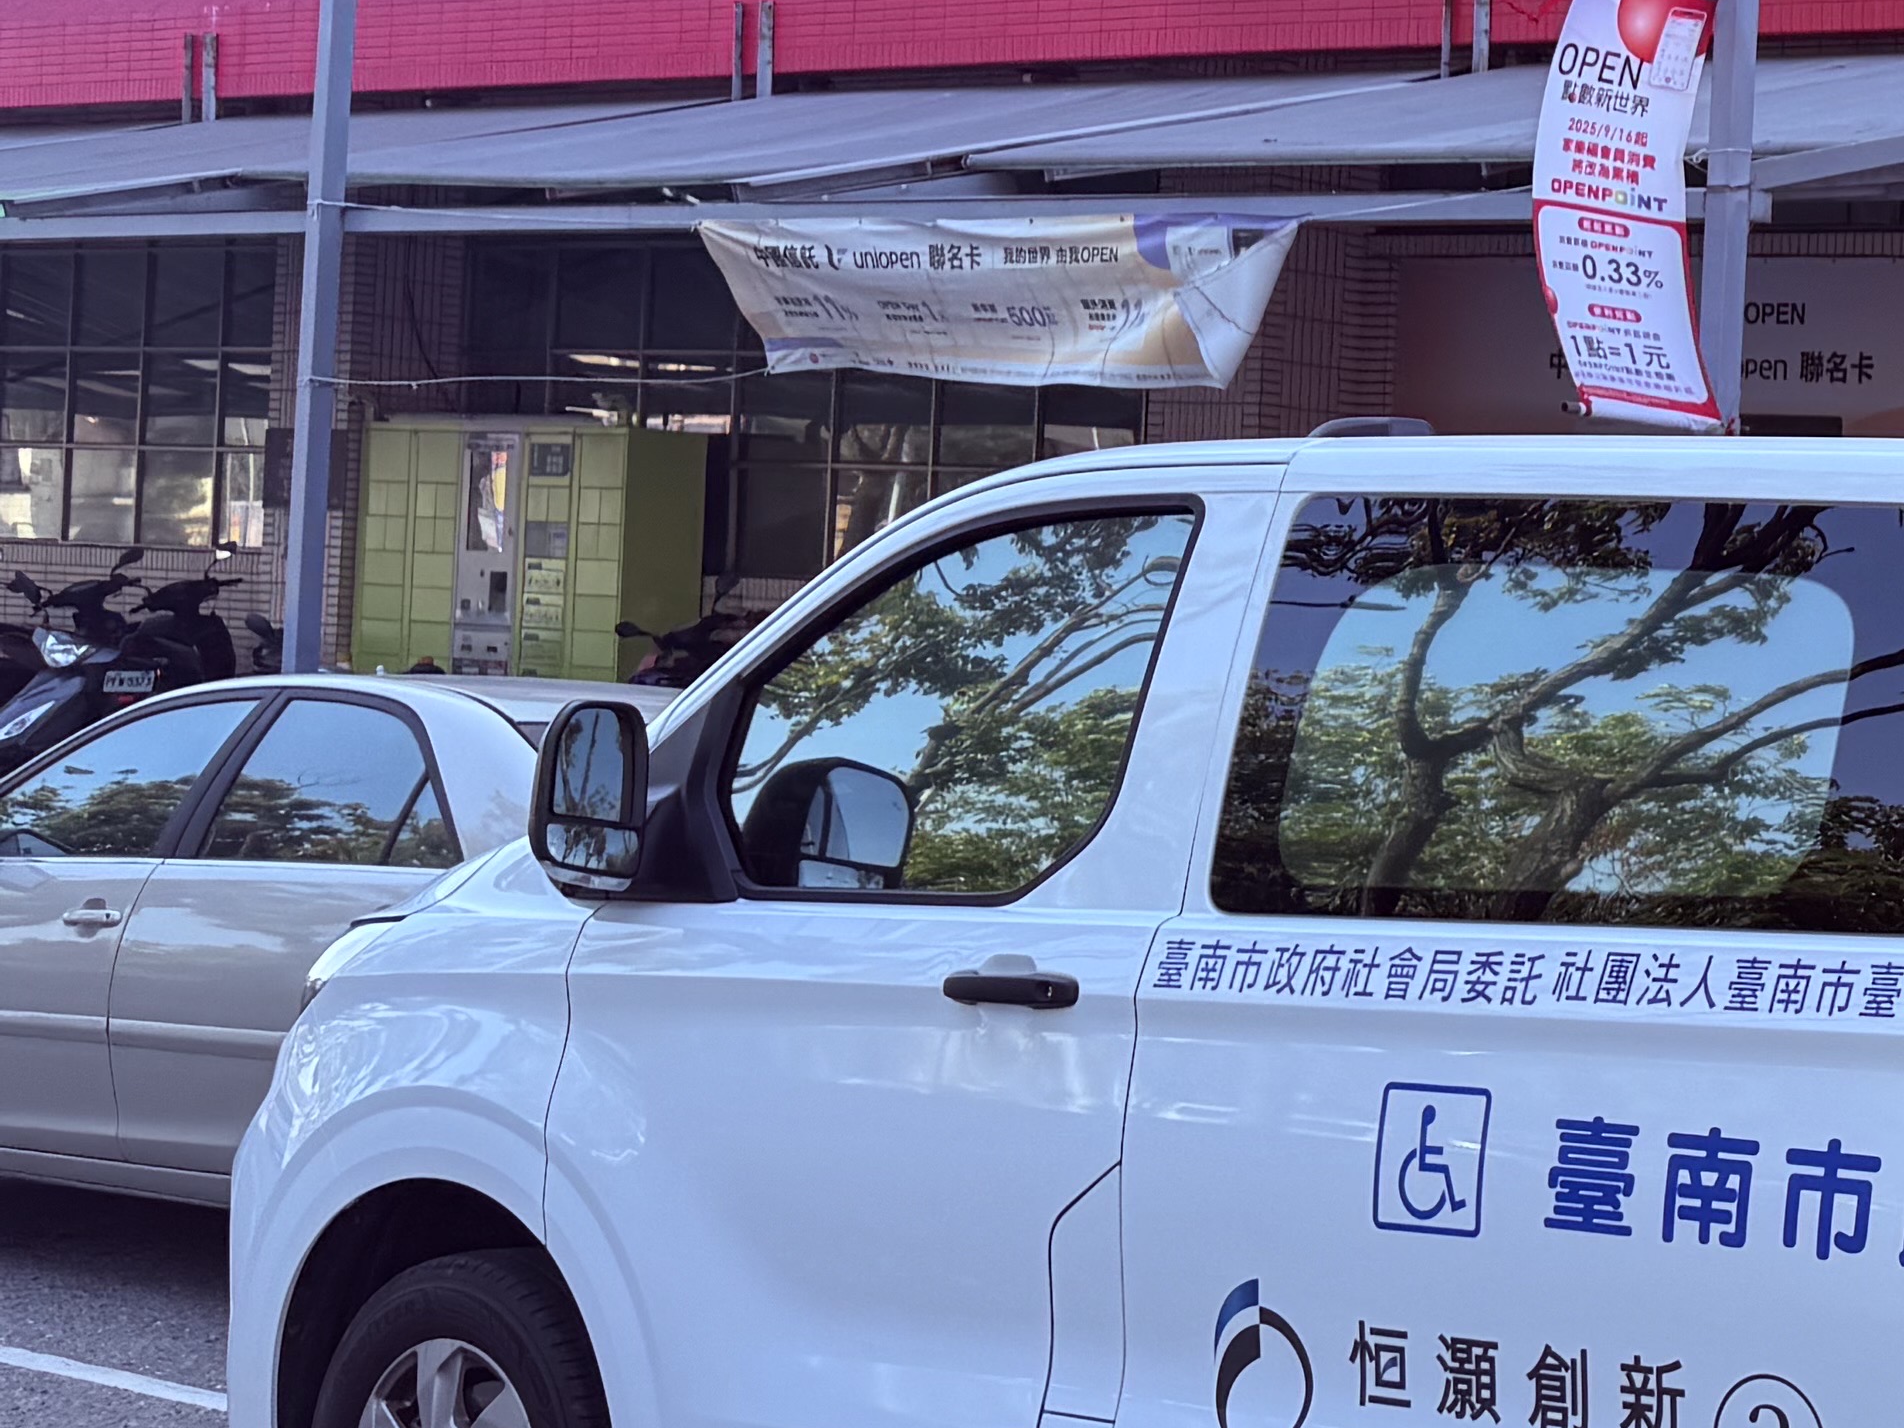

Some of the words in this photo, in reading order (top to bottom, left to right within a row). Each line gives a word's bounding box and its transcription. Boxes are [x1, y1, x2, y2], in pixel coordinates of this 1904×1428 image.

[1558, 43, 1644, 90] OPEN
[1561, 80, 1650, 118] 點數新世界
[1582, 254, 1664, 289] 0.33%
[1800, 351, 1875, 385] 聯名卡
[1153, 938, 1543, 1006] 臺南市政府社會局委託
